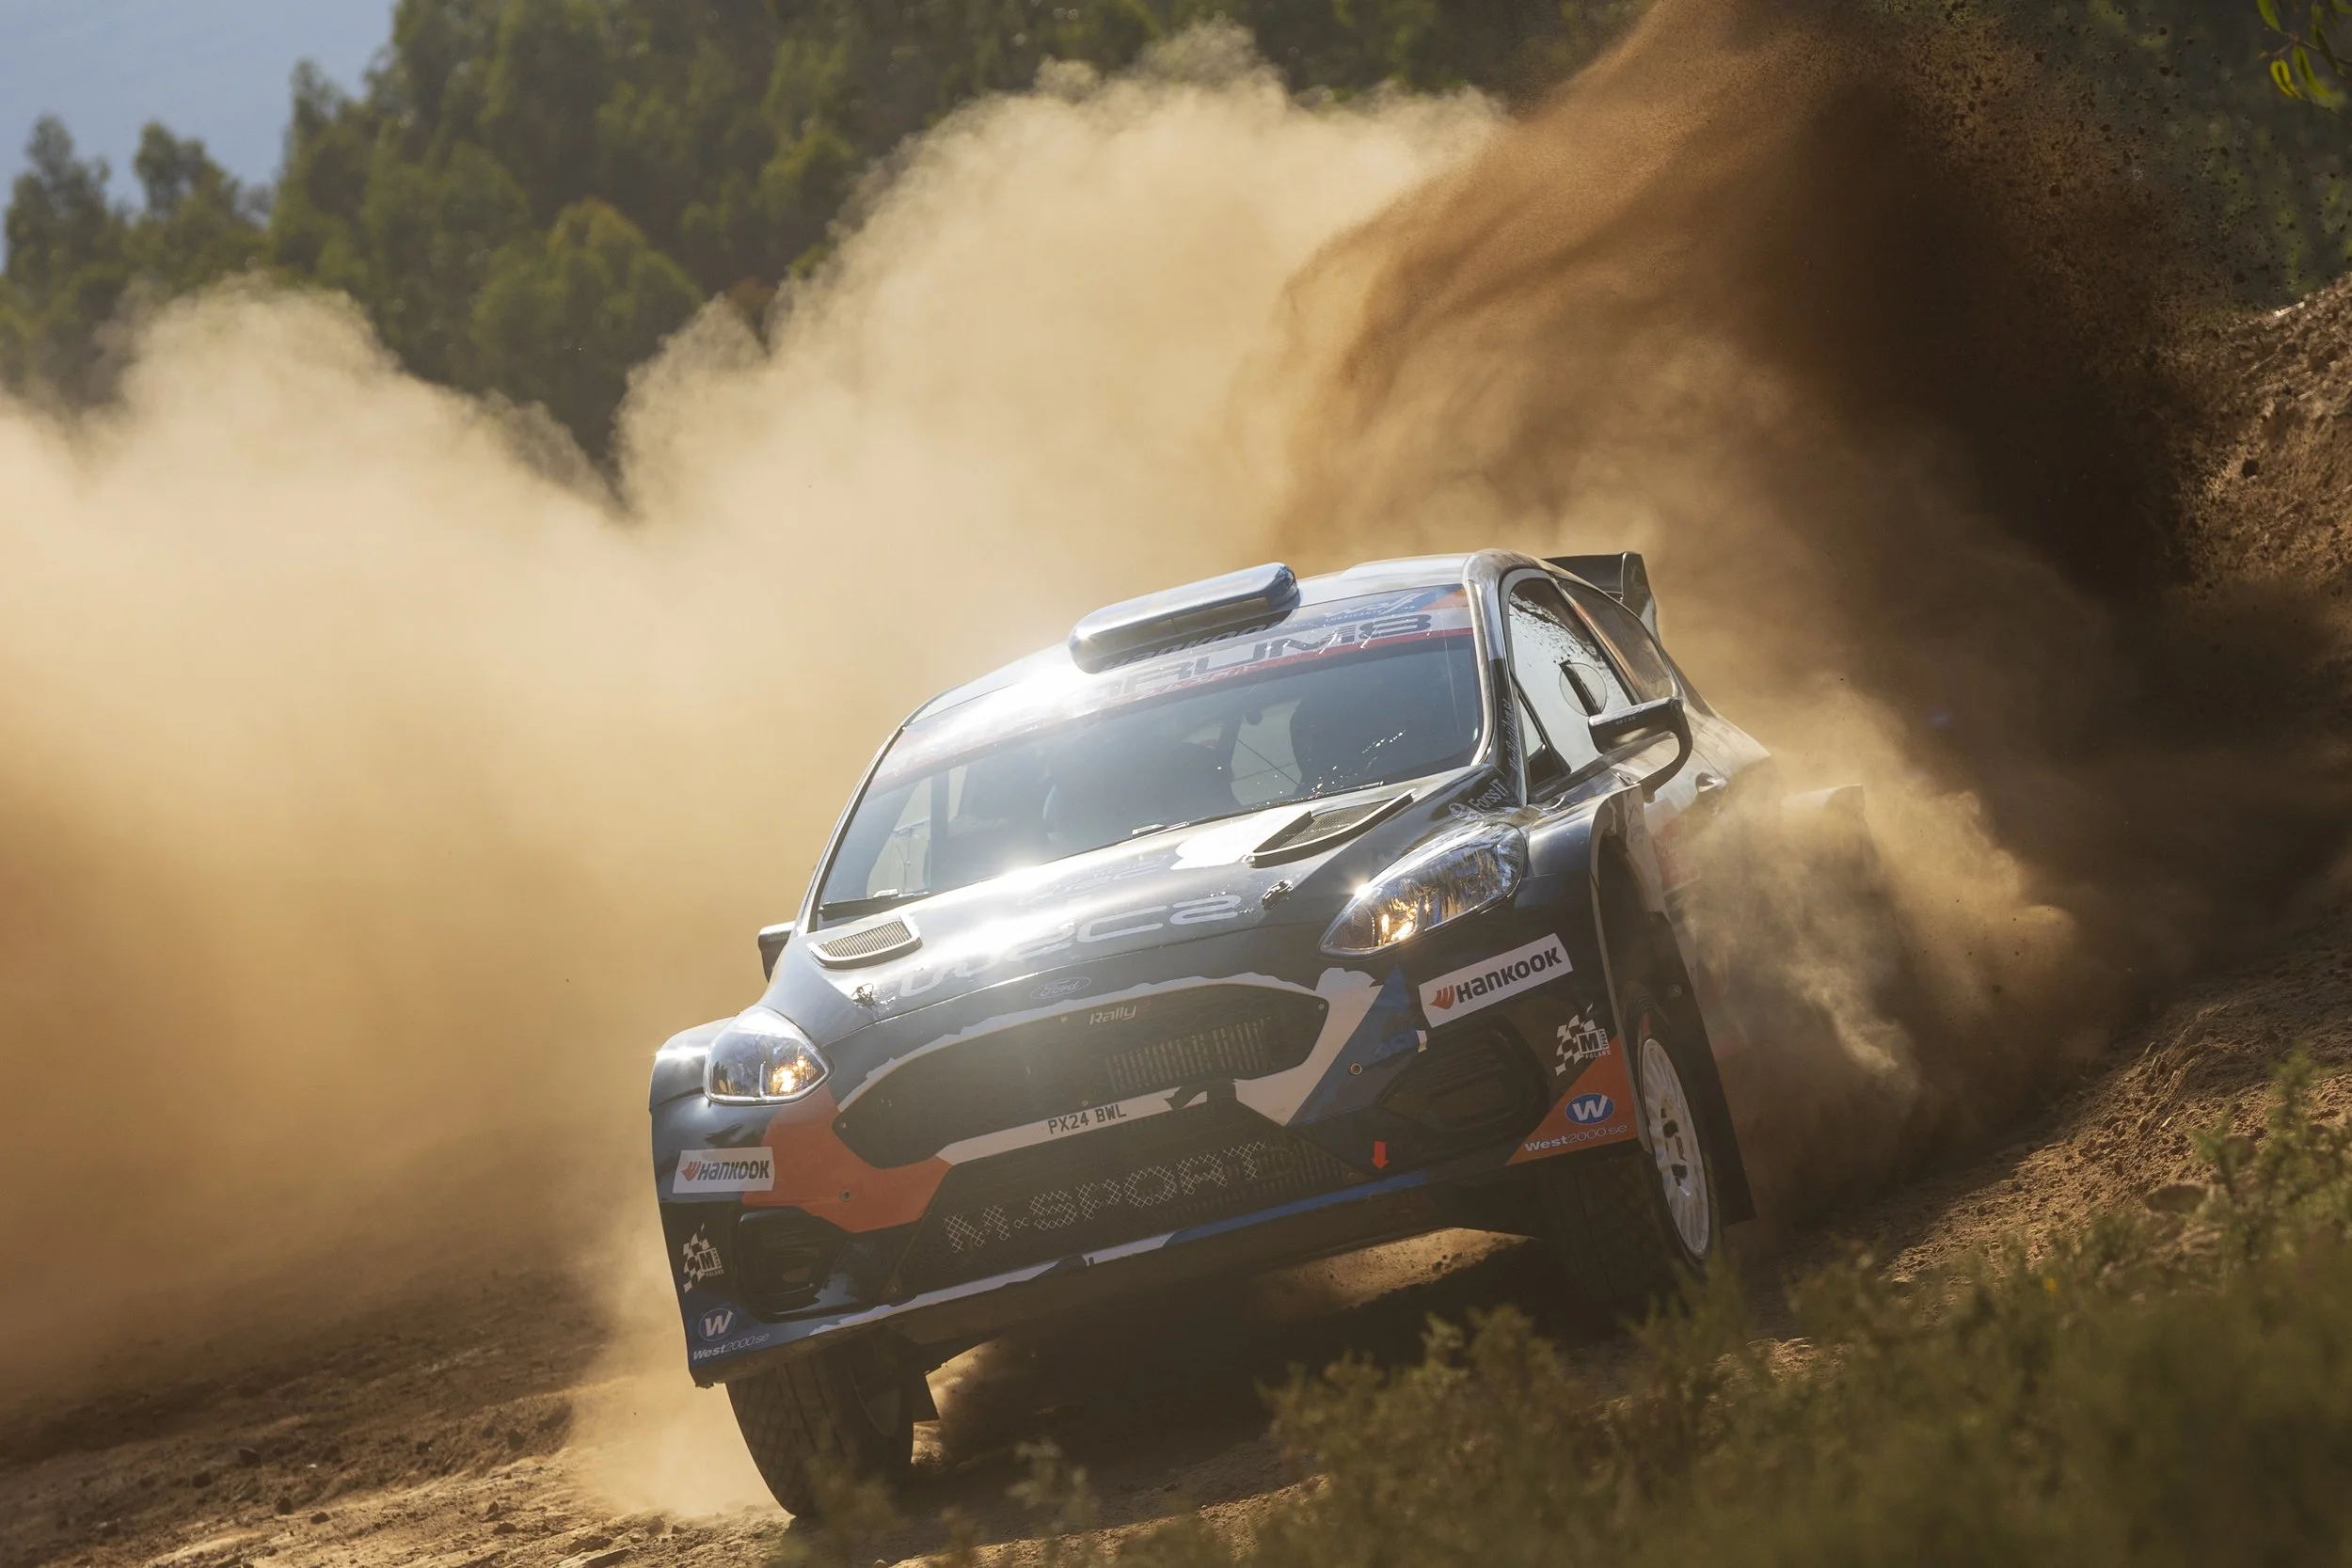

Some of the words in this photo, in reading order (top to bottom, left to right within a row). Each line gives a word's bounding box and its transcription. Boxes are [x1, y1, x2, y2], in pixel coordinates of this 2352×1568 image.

[1040, 979, 1080, 997] Ford
[1048, 1112, 1089, 1134] PX24
[1094, 1103, 1127, 1123] BWL
[1572, 1095, 1609, 1122] W
[944, 1141, 1267, 1253] M-SPORT
[705, 1310, 734, 1337] W
